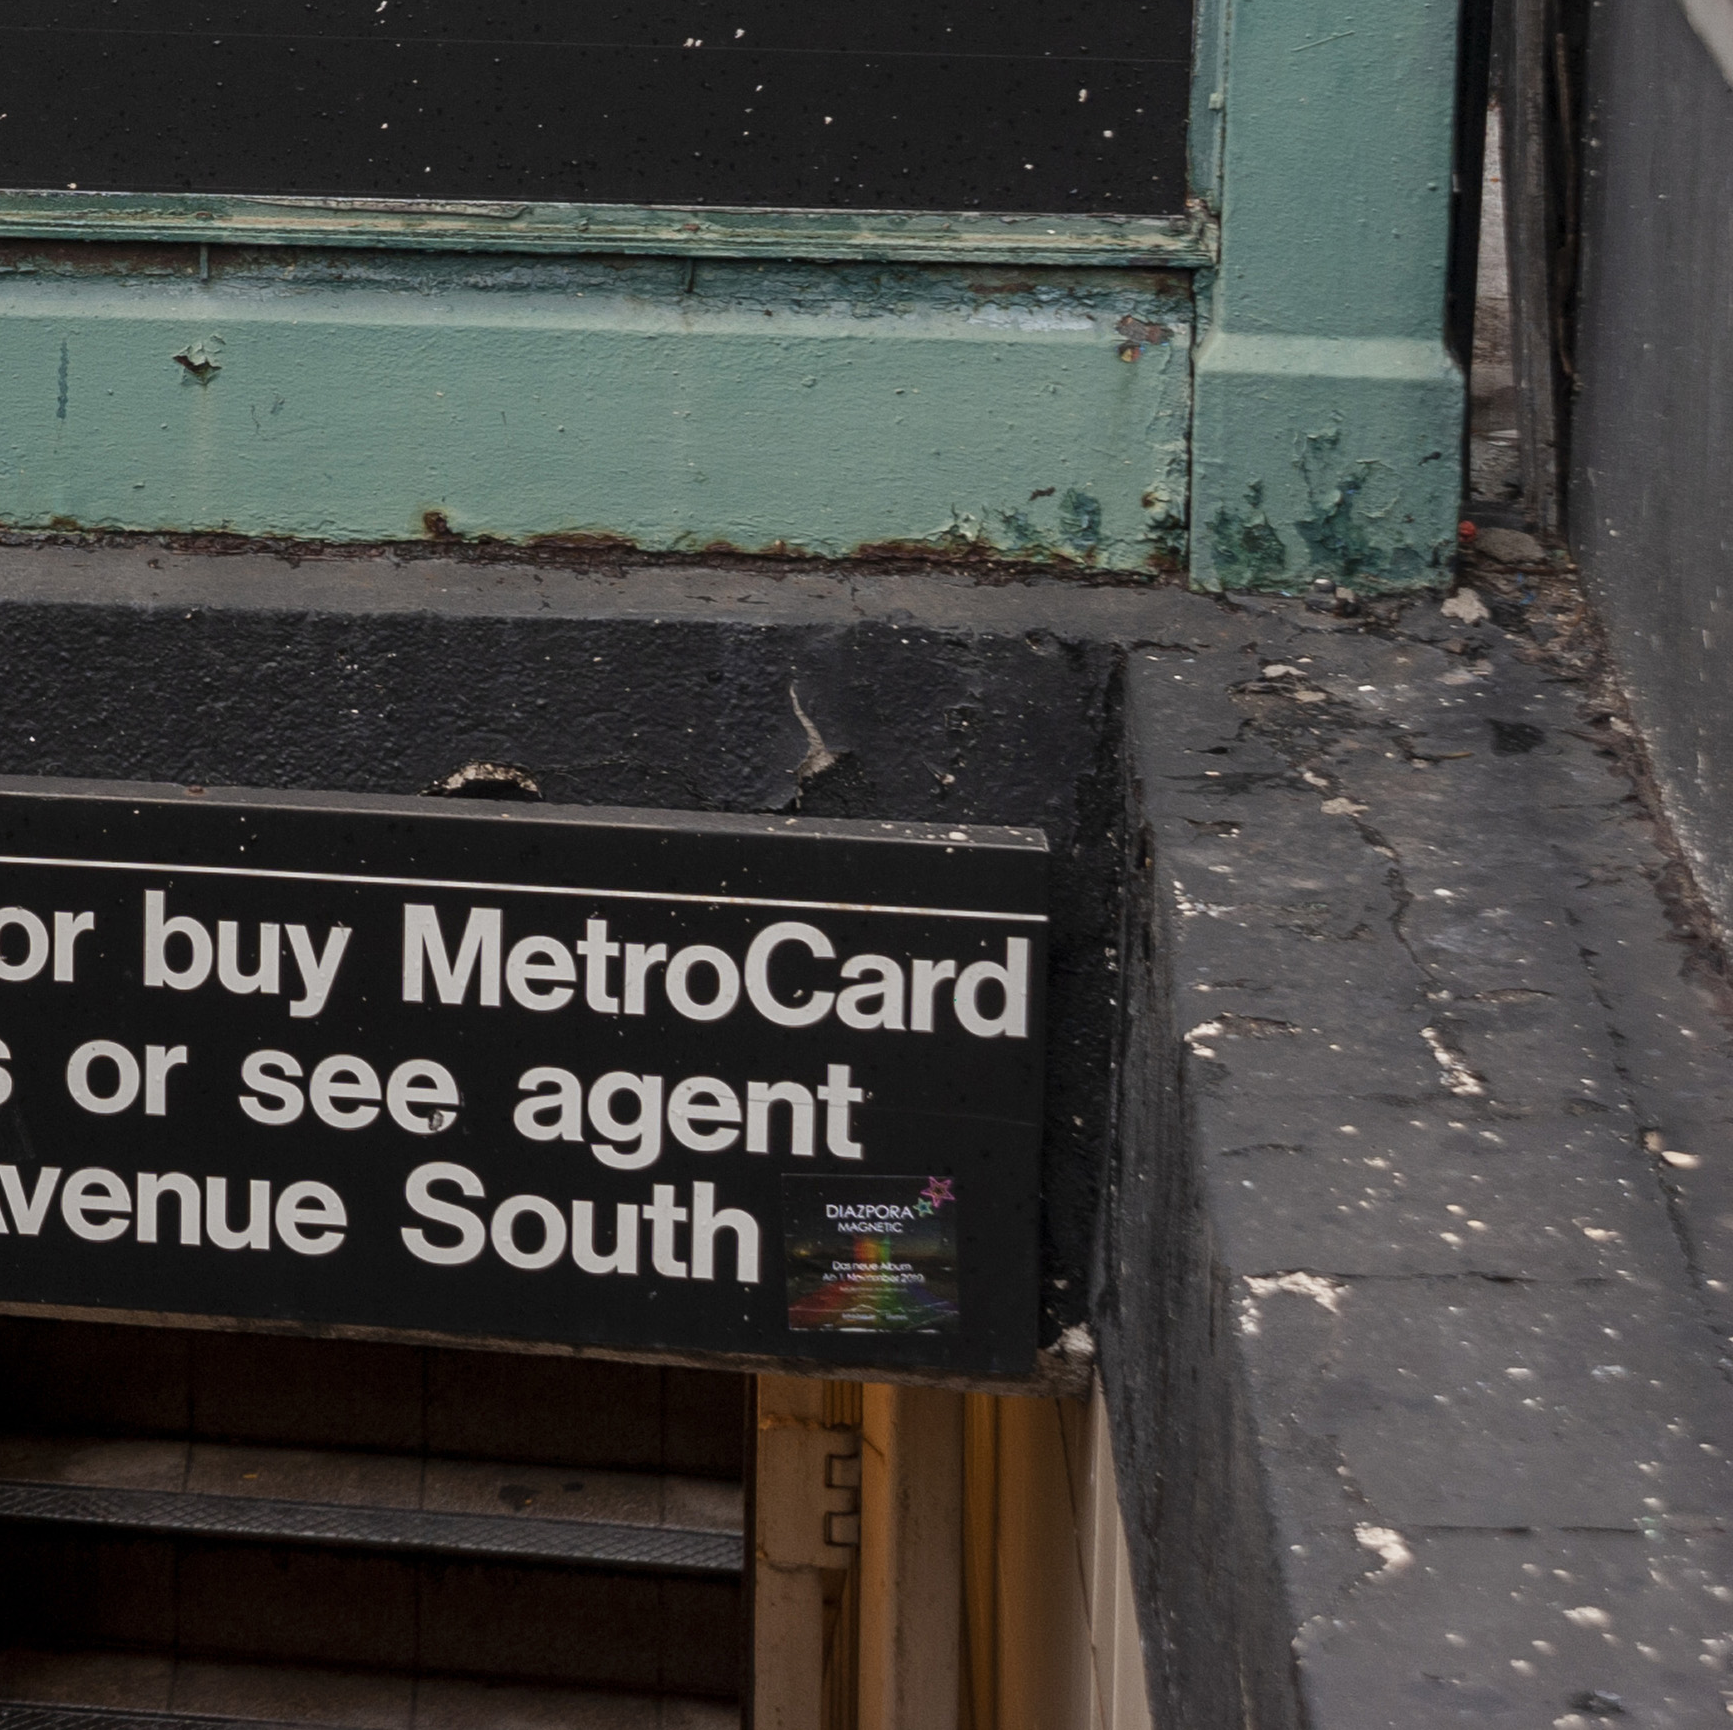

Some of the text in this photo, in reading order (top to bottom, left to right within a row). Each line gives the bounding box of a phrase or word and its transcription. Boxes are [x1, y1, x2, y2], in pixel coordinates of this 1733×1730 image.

[145, 889, 353, 1017] buy
[403, 904, 1029, 1037] MetroCard
[66, 1038, 188, 1115] or
[238, 1049, 459, 1134] see
[514, 1063, 863, 1169] agent
[401, 1161, 759, 1282] South
[825, 1204, 916, 1220] DIAZPORA
[837, 1221, 904, 1234] MAGNETIC
